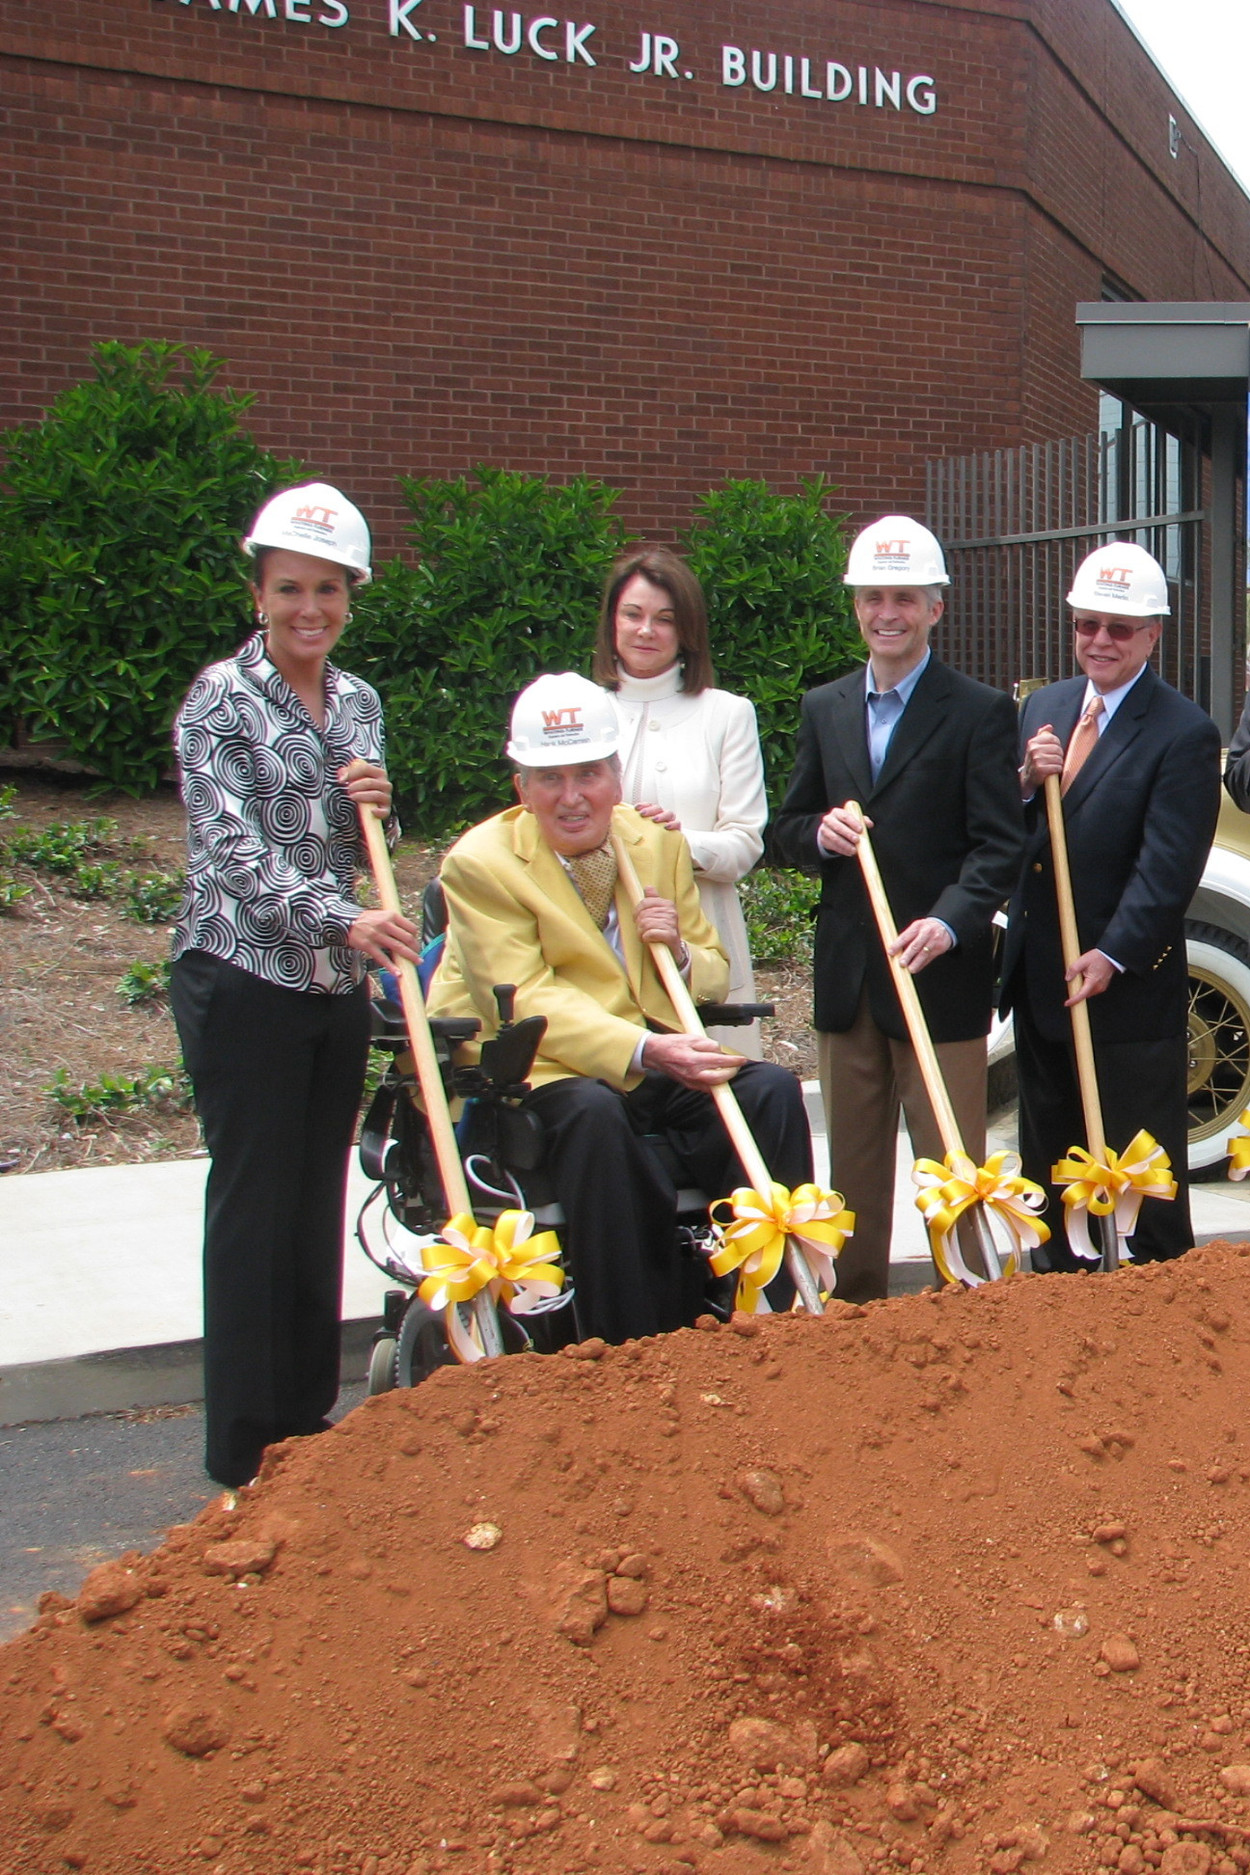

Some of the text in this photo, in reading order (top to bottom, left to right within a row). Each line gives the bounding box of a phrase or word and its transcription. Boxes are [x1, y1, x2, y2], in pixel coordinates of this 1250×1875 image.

[389, 0, 437, 42] K.
[464, 4, 597, 67] LUCK
[629, 32, 695, 79] JR.
[722, 45, 937, 115] BUILDING
[296, 504, 338, 523] WT
[875, 540, 911, 553] WT
[1100, 567, 1134, 582] WT
[541, 707, 582, 726] WT
